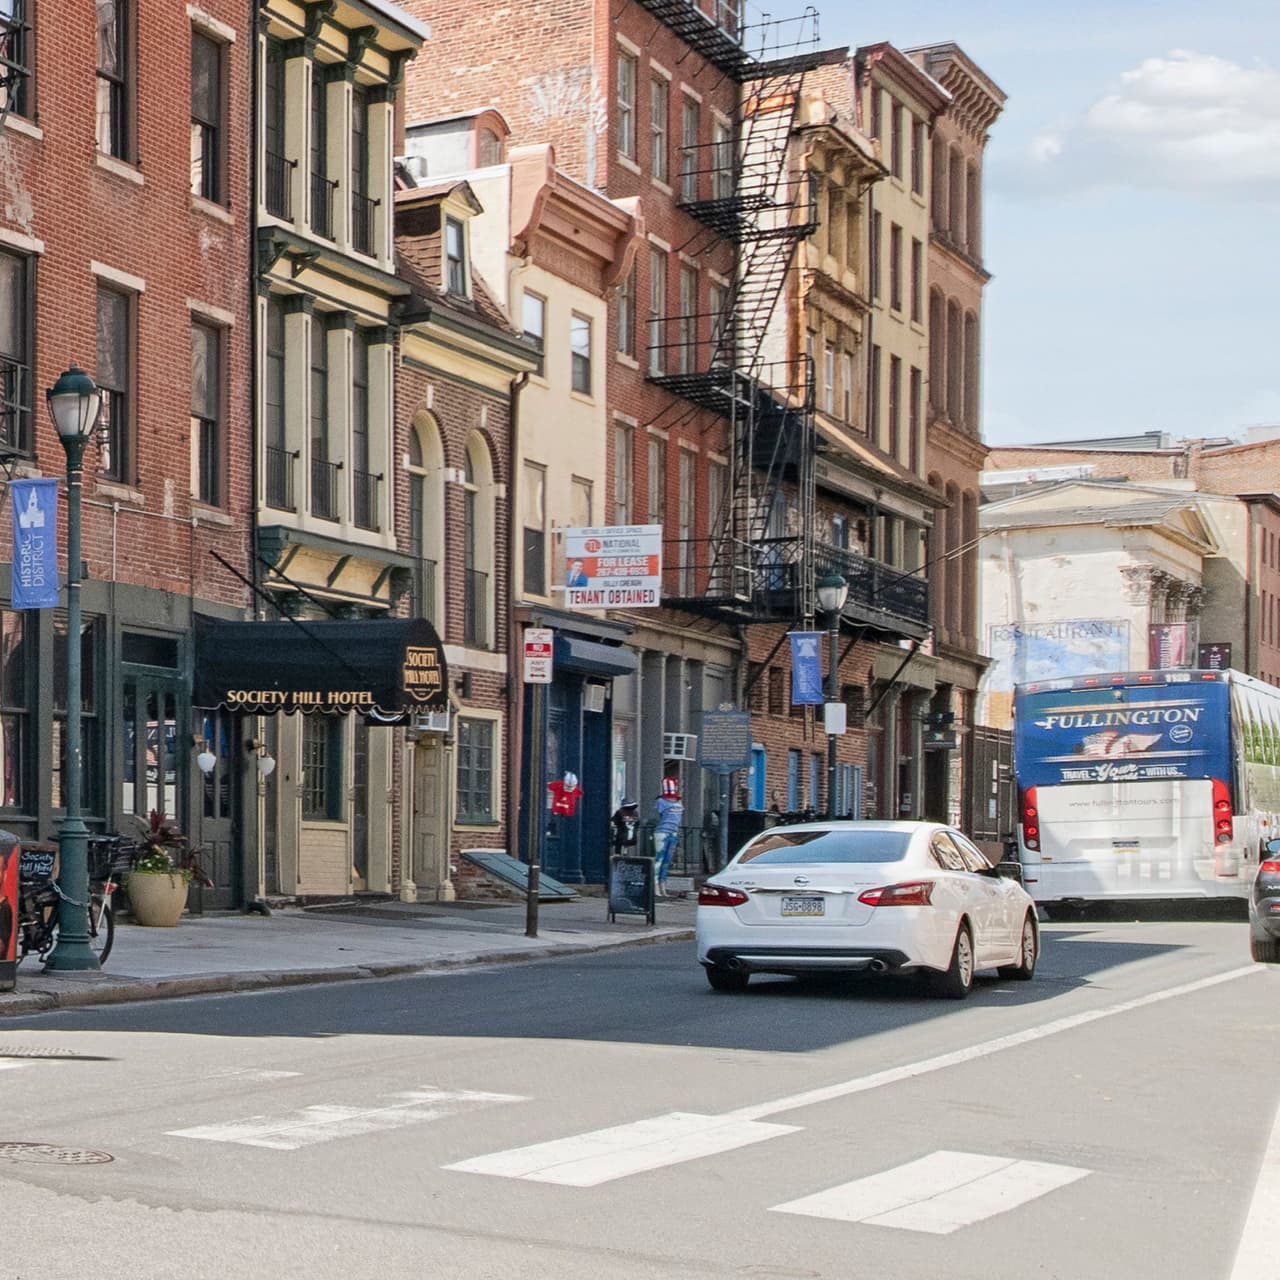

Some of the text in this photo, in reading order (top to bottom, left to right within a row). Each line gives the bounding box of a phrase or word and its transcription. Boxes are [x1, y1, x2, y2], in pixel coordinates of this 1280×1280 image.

[33, 534, 44, 587] DISTRICT
[597, 556, 649, 568] FOR LEASE
[570, 589, 655, 604] TENANT OBTAINED
[227, 690, 375, 705] SOCIETY HILL HOTEL
[1041, 708, 1203, 729] FULLINGTON
